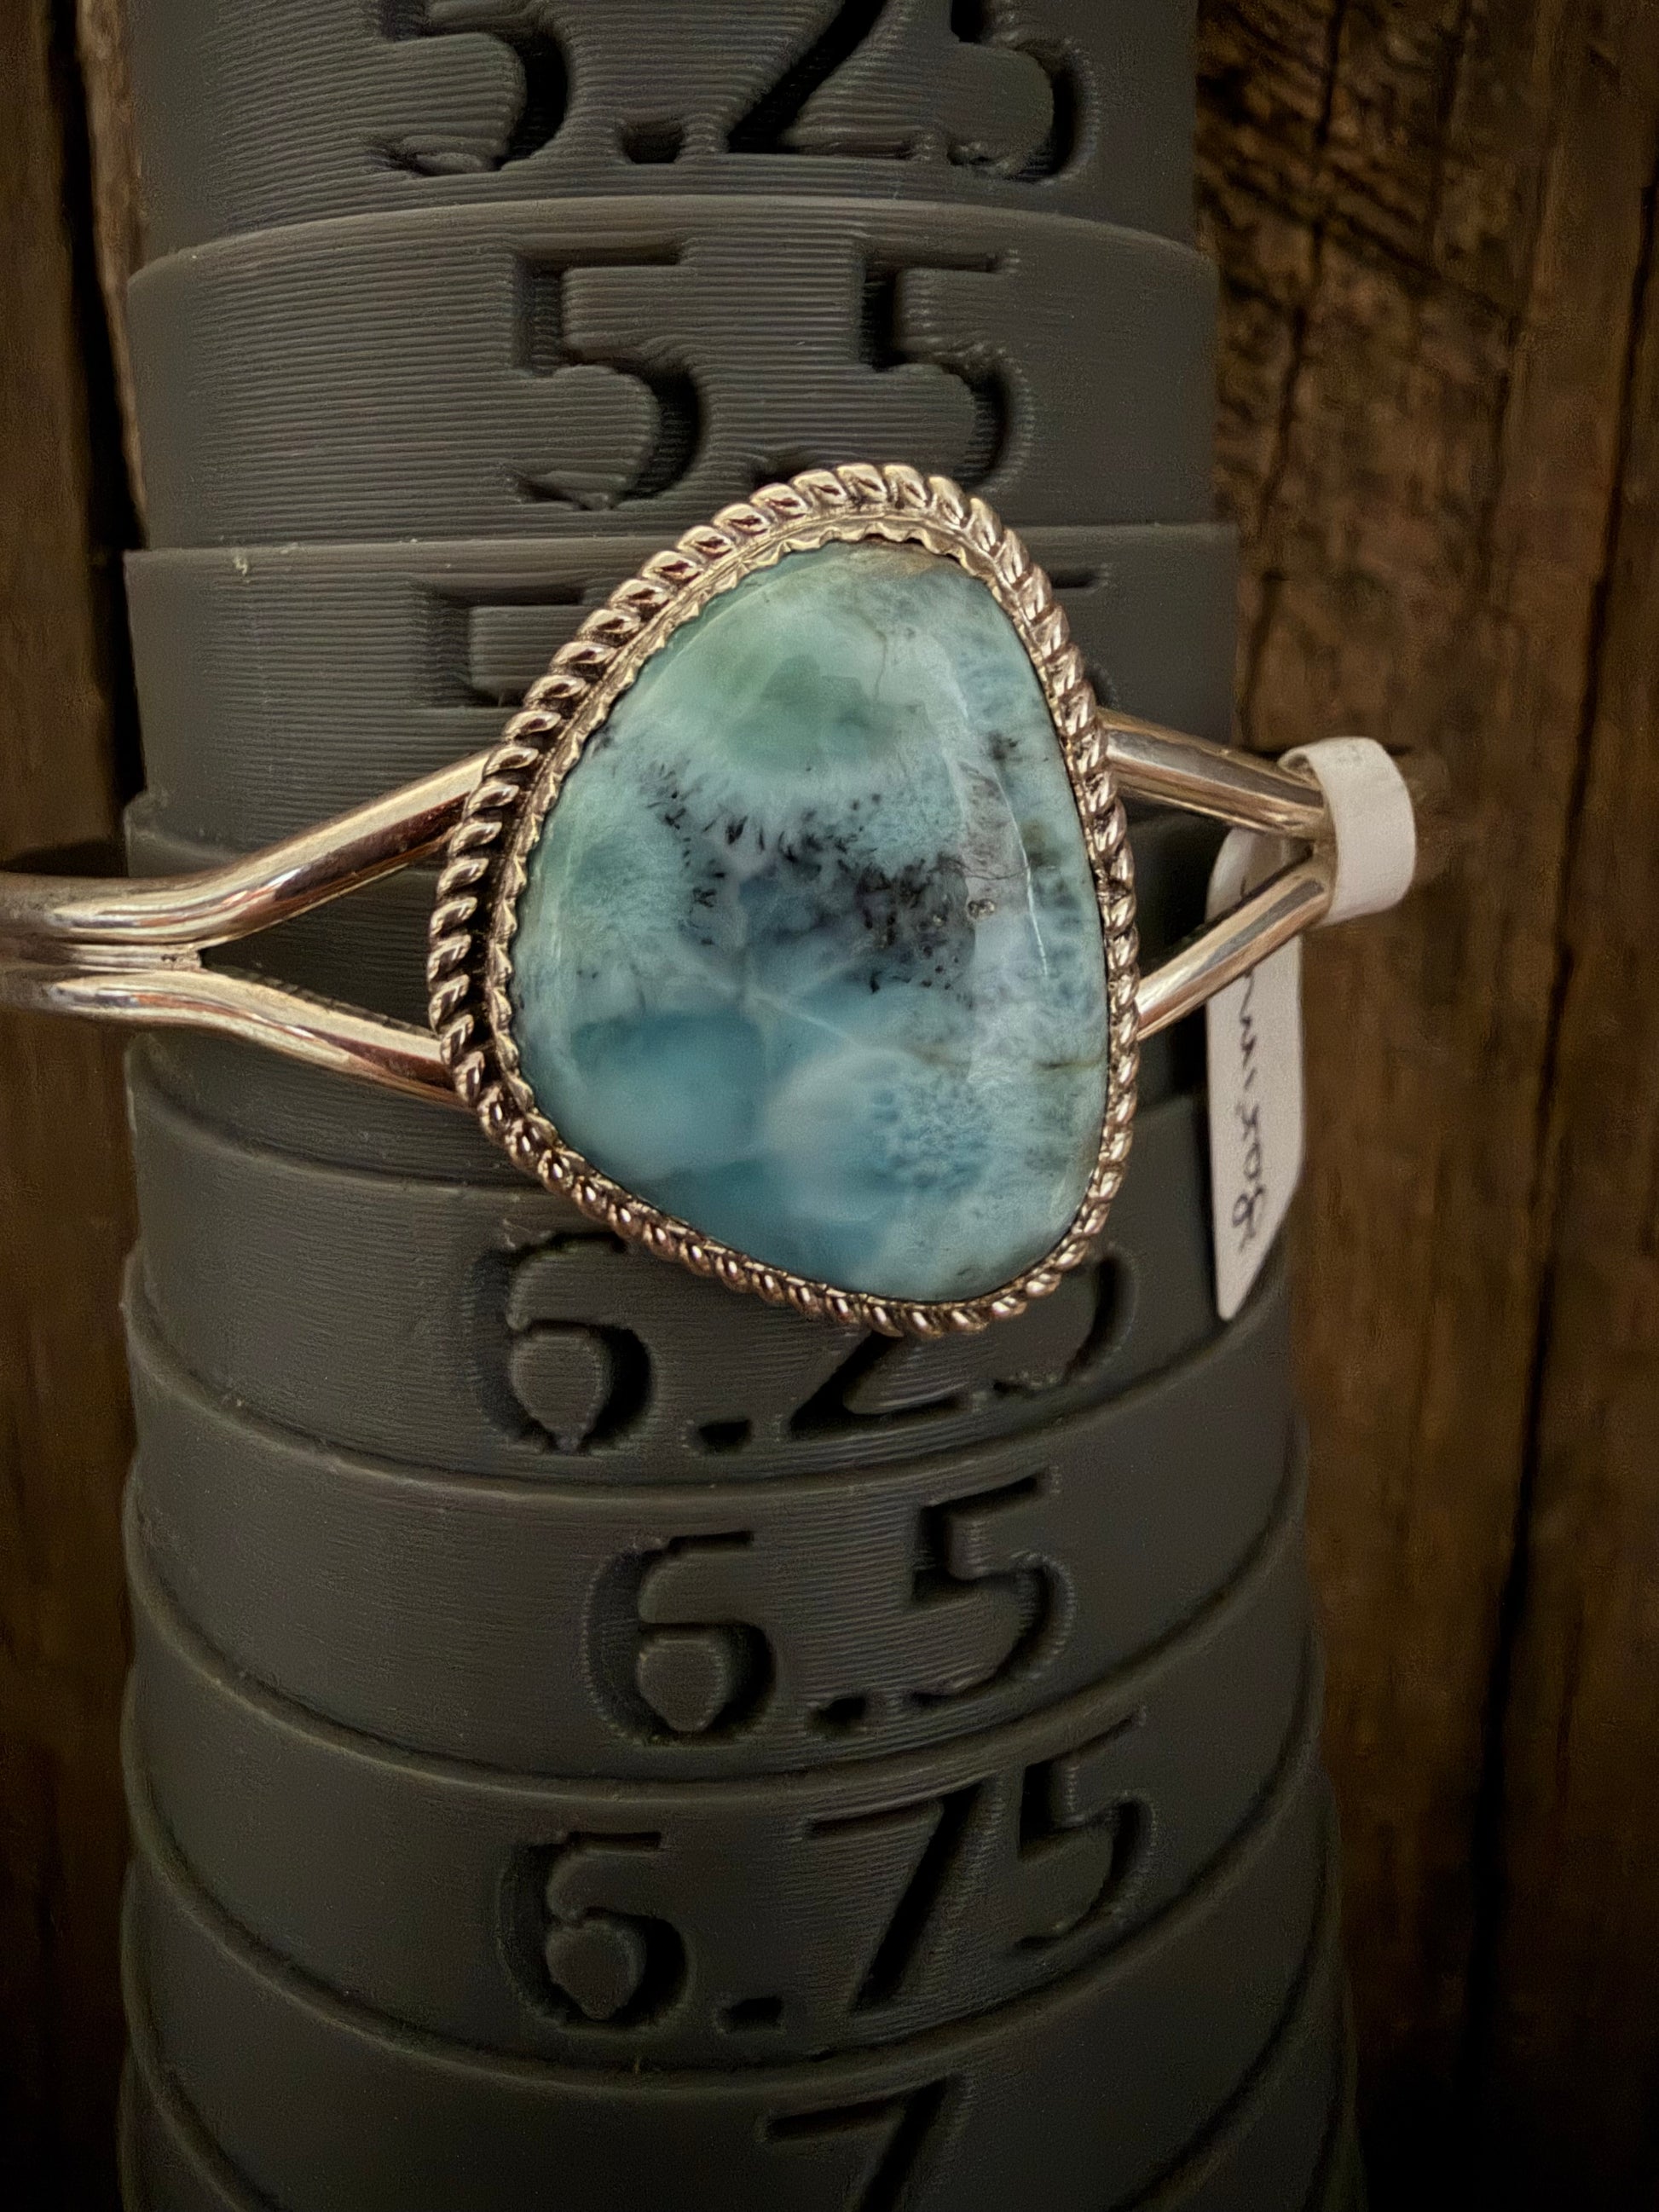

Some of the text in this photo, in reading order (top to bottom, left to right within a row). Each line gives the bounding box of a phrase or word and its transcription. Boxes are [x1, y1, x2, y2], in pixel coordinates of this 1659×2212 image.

[365, 0, 1095, 183] 5.25
[584, 1476, 1074, 1746] 6.5
[499, 1709, 1151, 2036] 6.75
